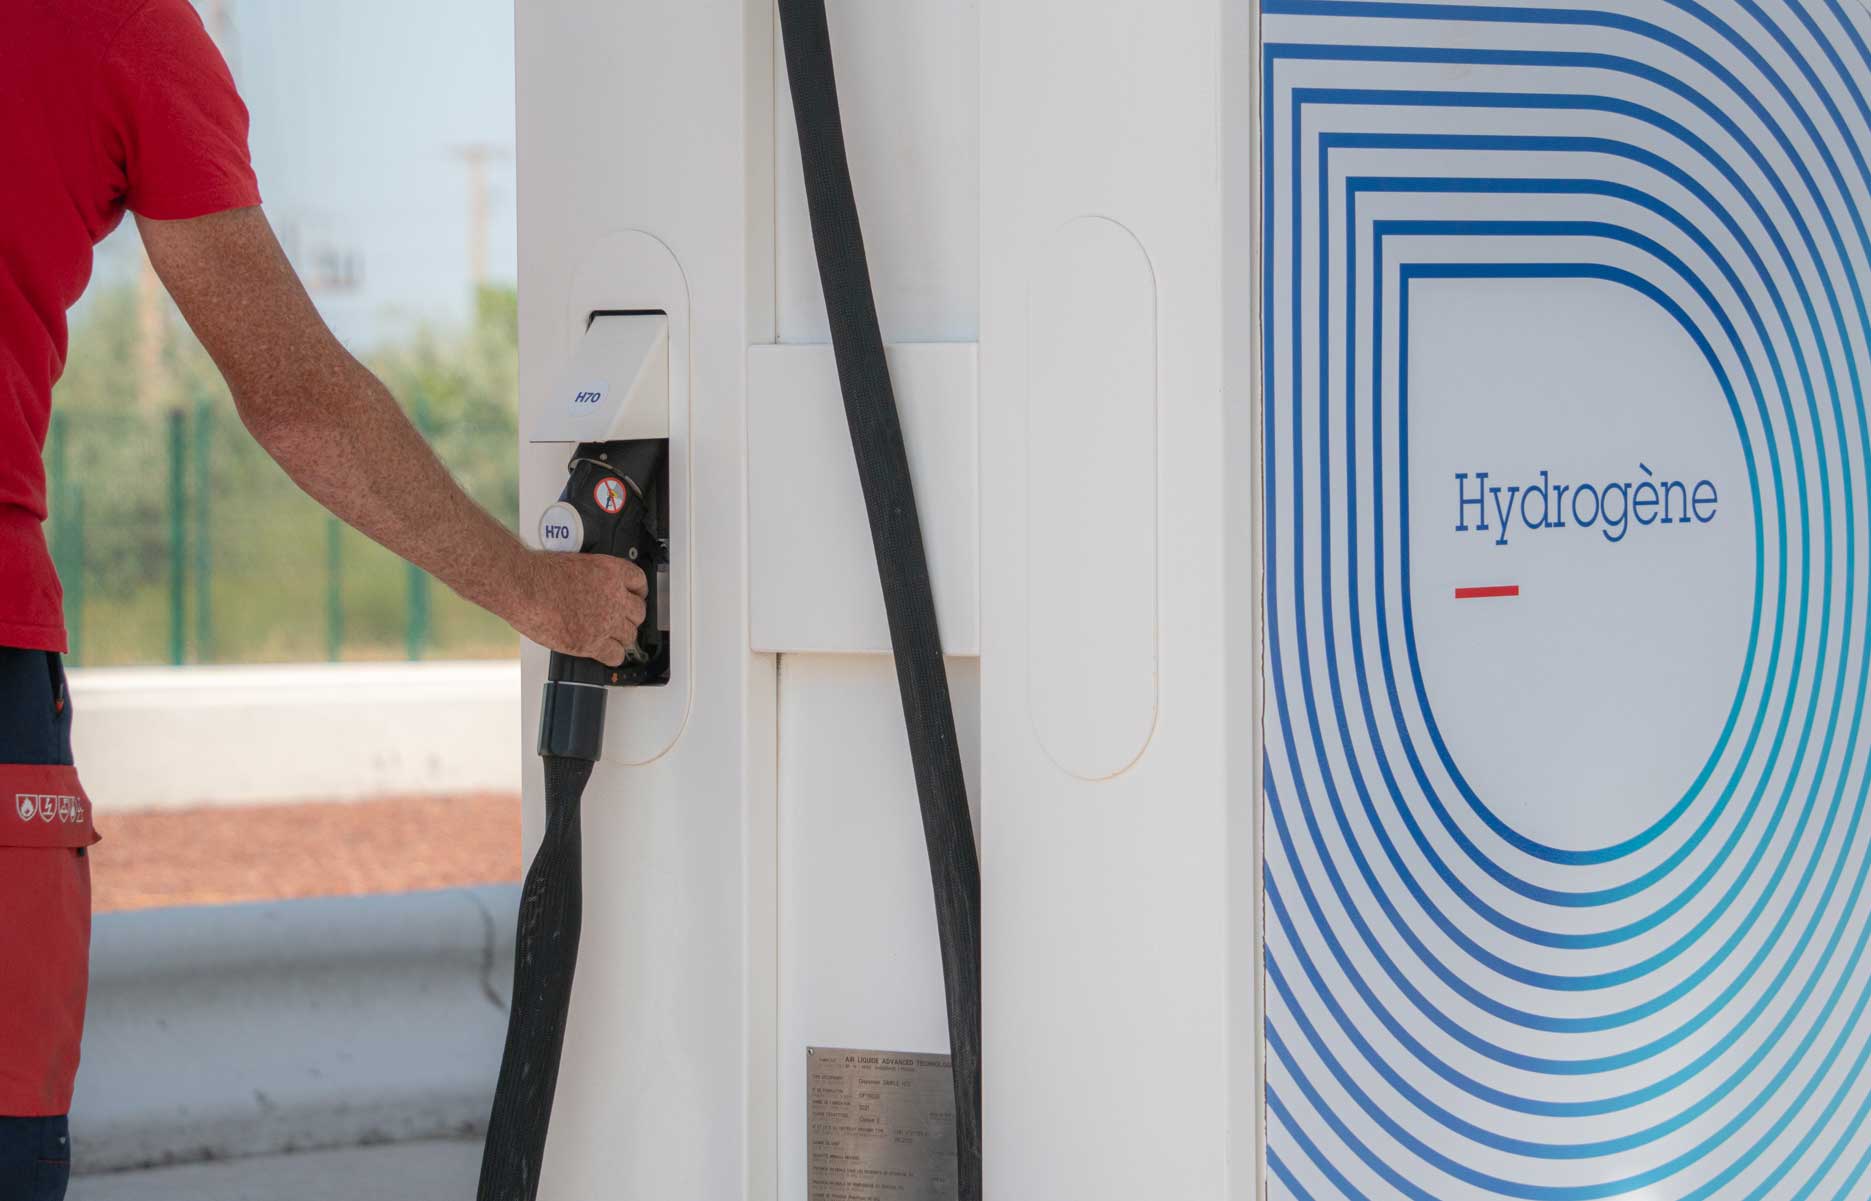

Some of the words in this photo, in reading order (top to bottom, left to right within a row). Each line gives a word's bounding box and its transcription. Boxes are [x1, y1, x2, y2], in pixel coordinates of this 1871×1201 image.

[575, 392, 600, 403] H70
[1455, 462, 1718, 545] Hydrogène
[545, 525, 570, 539] H70
